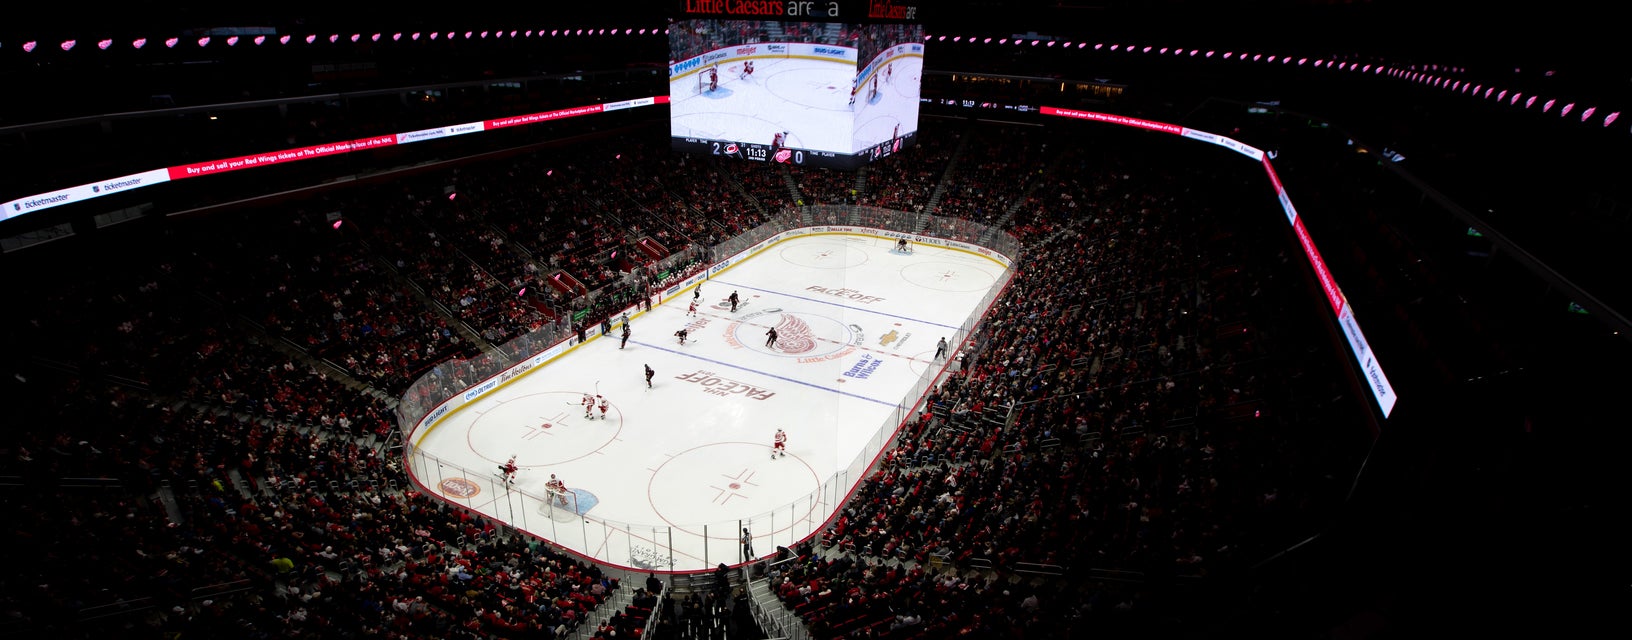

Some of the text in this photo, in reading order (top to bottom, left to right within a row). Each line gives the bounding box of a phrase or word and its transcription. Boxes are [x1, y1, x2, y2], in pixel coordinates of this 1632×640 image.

[686, 0, 838, 16] Little Caesars area
[316, 146, 334, 154] Official
[713, 142, 720, 155] 2
[746, 148, 766, 157] 11:13
[795, 151, 803, 164] 0
[104, 178, 142, 192] ticketmaster
[24, 193, 69, 208] ticketmaster
[806, 285, 886, 302] FACE-OFF
[824, 347, 856, 360] Caesars
[500, 364, 532, 383] Tim Hortons
[842, 359, 868, 377] Burns
[856, 359, 883, 379] Wilcox
[478, 381, 496, 394] DETROIT
[674, 372, 776, 400] FACE-OFF
[703, 387, 730, 396] NHL
[425, 406, 447, 426] BUD LIGHT
